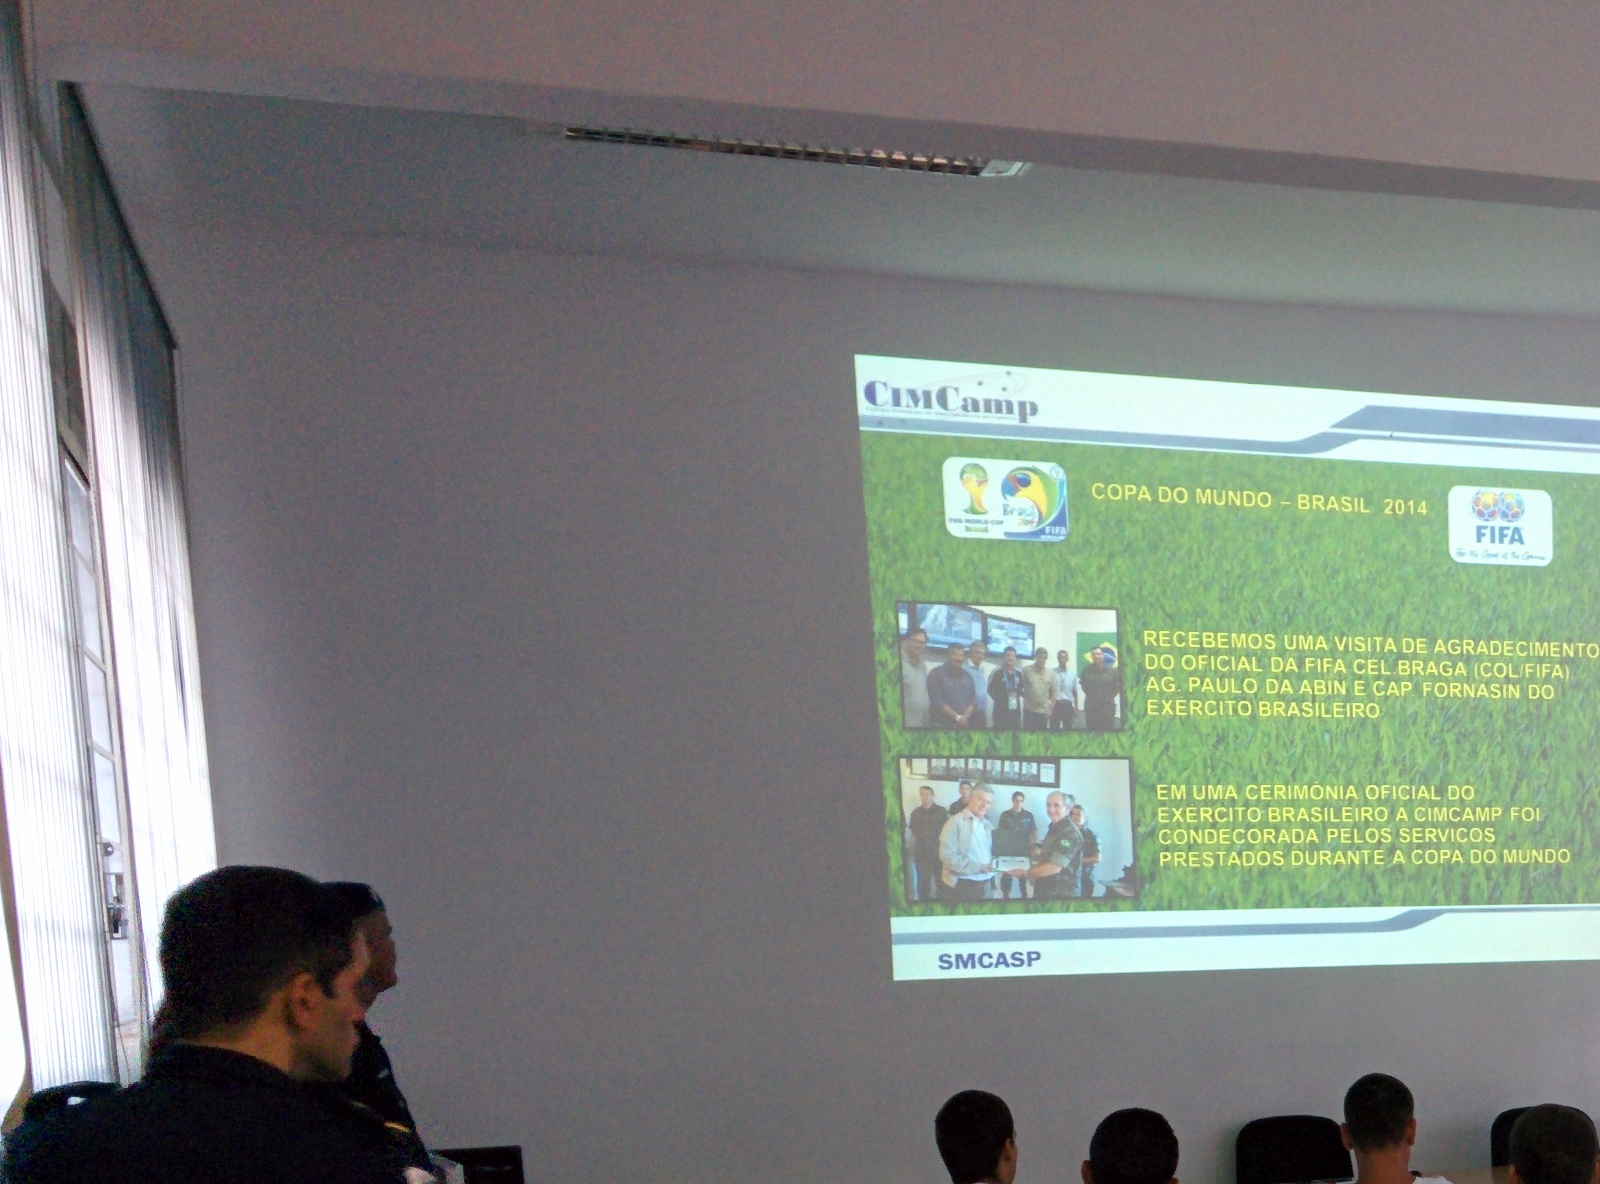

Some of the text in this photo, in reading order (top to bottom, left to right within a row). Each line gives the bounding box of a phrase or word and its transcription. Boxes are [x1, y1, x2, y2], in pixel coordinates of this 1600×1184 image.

[1091, 482, 1151, 502] COPA
[1158, 486, 1188, 504] DO
[1196, 488, 1272, 508] MUNDO
[1298, 494, 1370, 514] BRASIL
[1383, 498, 1428, 516] 2014
[1475, 525, 1525, 545] FIFA
[1143, 630, 1600, 659] RECEBEMOS UMA VISITA DE AGRADECIMENTO
[1145, 653, 1175, 670] DO
[1181, 654, 1262, 672] OFICIAL
[1270, 657, 1298, 673] DA
[1305, 658, 1346, 674] FIFA
[1188, 677, 1258, 694] PAULO
[1265, 678, 1294, 695] DA
[1299, 679, 1346, 695] ABIN
[1354, 680, 1366, 696] E
[1423, 682, 1520, 699] FORNASIN
[1528, 684, 1555, 700] DO
[1258, 701, 1380, 719] BRASILEIRO
[1156, 781, 1475, 801] EM UMA CERIMÔNIA OFICIAL DO
[1268, 806, 1388, 823] BRASILEIRO
[1395, 807, 1408, 822] A
[1414, 806, 1502, 822] CIMCAMP
[1510, 806, 1540, 822] FOI
[1158, 828, 1319, 845] CONDECORADA
[1327, 827, 1392, 844] PELOS
[1159, 848, 1571, 867] PRESTADOS DURANTE A COPA DO MUNDO
[938, 951, 1042, 971] SMCASP
